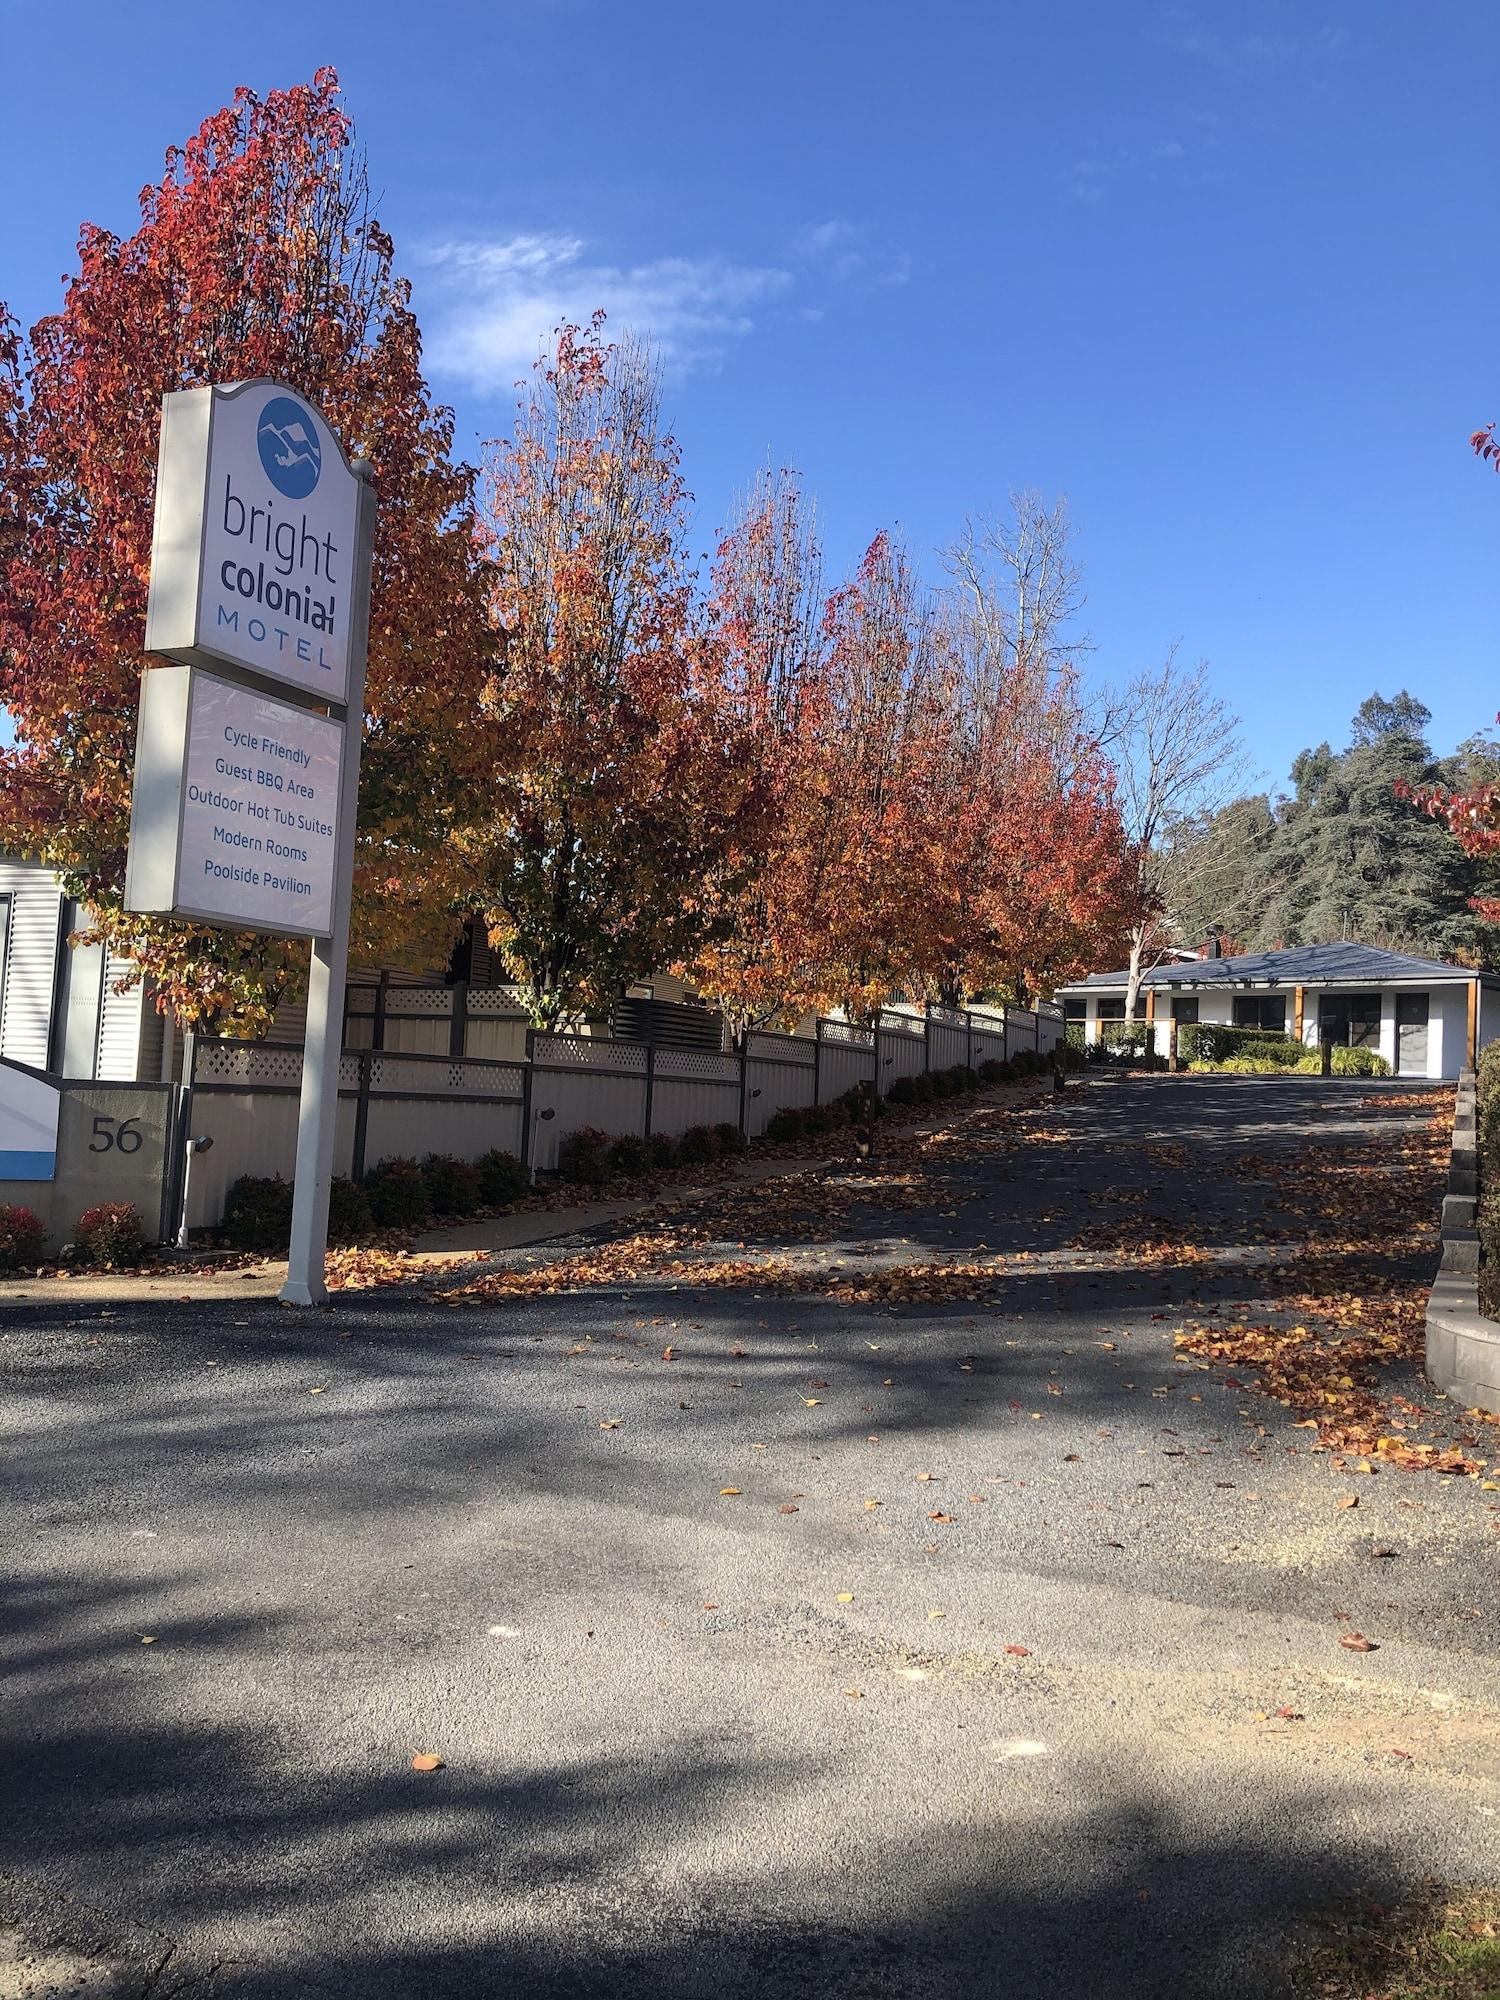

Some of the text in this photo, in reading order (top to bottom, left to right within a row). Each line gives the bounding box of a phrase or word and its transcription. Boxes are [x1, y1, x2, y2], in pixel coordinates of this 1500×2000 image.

[224, 474, 338, 584] bright
[221, 560, 335, 635] colonial
[218, 605, 331, 670] MOTEL
[224, 726, 311, 768] Cycle Friendly
[215, 758, 314, 799] Guest BBQ Area
[188, 785, 333, 836] Outdoor Hot Tub Suites
[213, 826, 308, 862] Modern Rooms
[204, 860, 311, 895] Poolside Pavilion
[89, 1117, 143, 1153] 56
